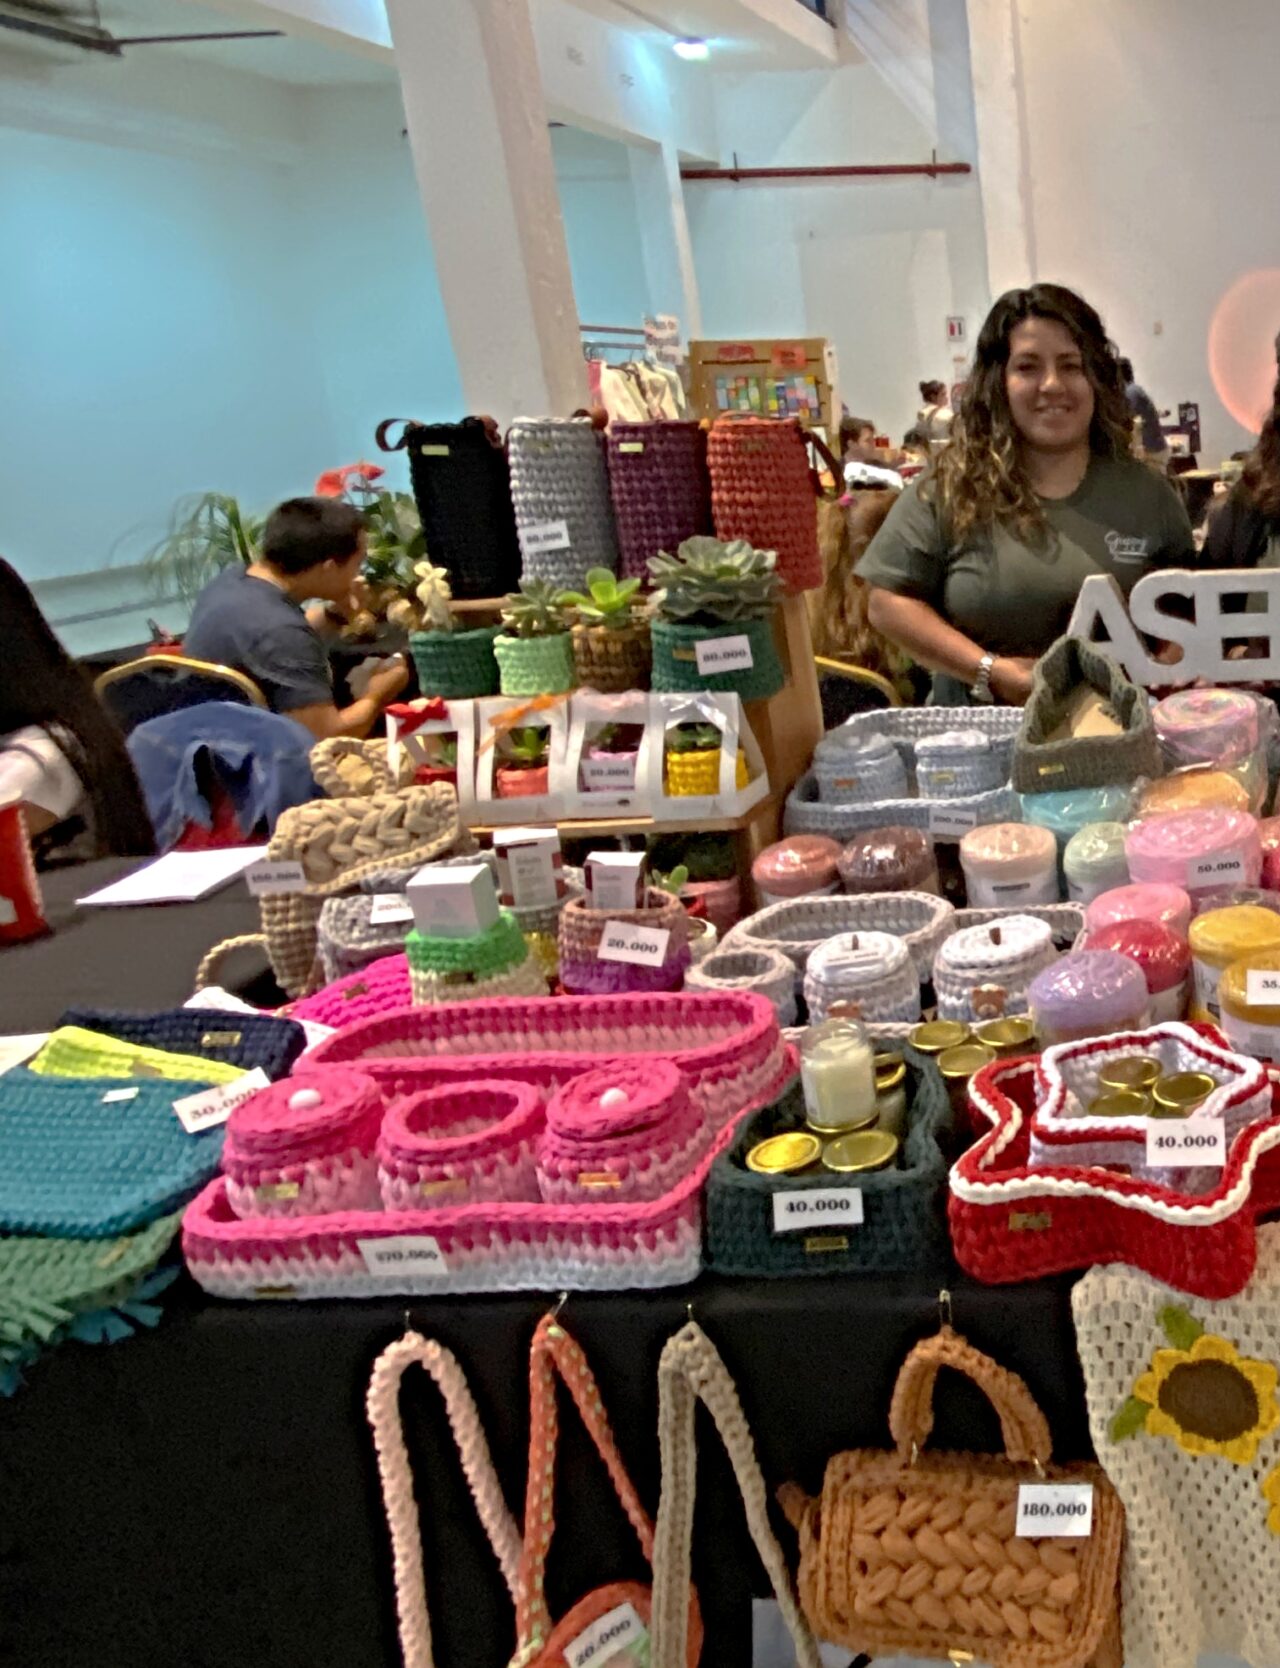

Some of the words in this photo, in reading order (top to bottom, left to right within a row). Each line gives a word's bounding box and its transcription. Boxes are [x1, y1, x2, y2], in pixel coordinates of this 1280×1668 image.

[1197, 861, 1240, 873] 50.000
[607, 938, 658, 954] 20.000
[1155, 1135, 1218, 1148] 40.000
[785, 1199, 850, 1213] 40.000
[1022, 1503, 1087, 1517] 180.000
[574, 1620, 631, 1665] 20.000
